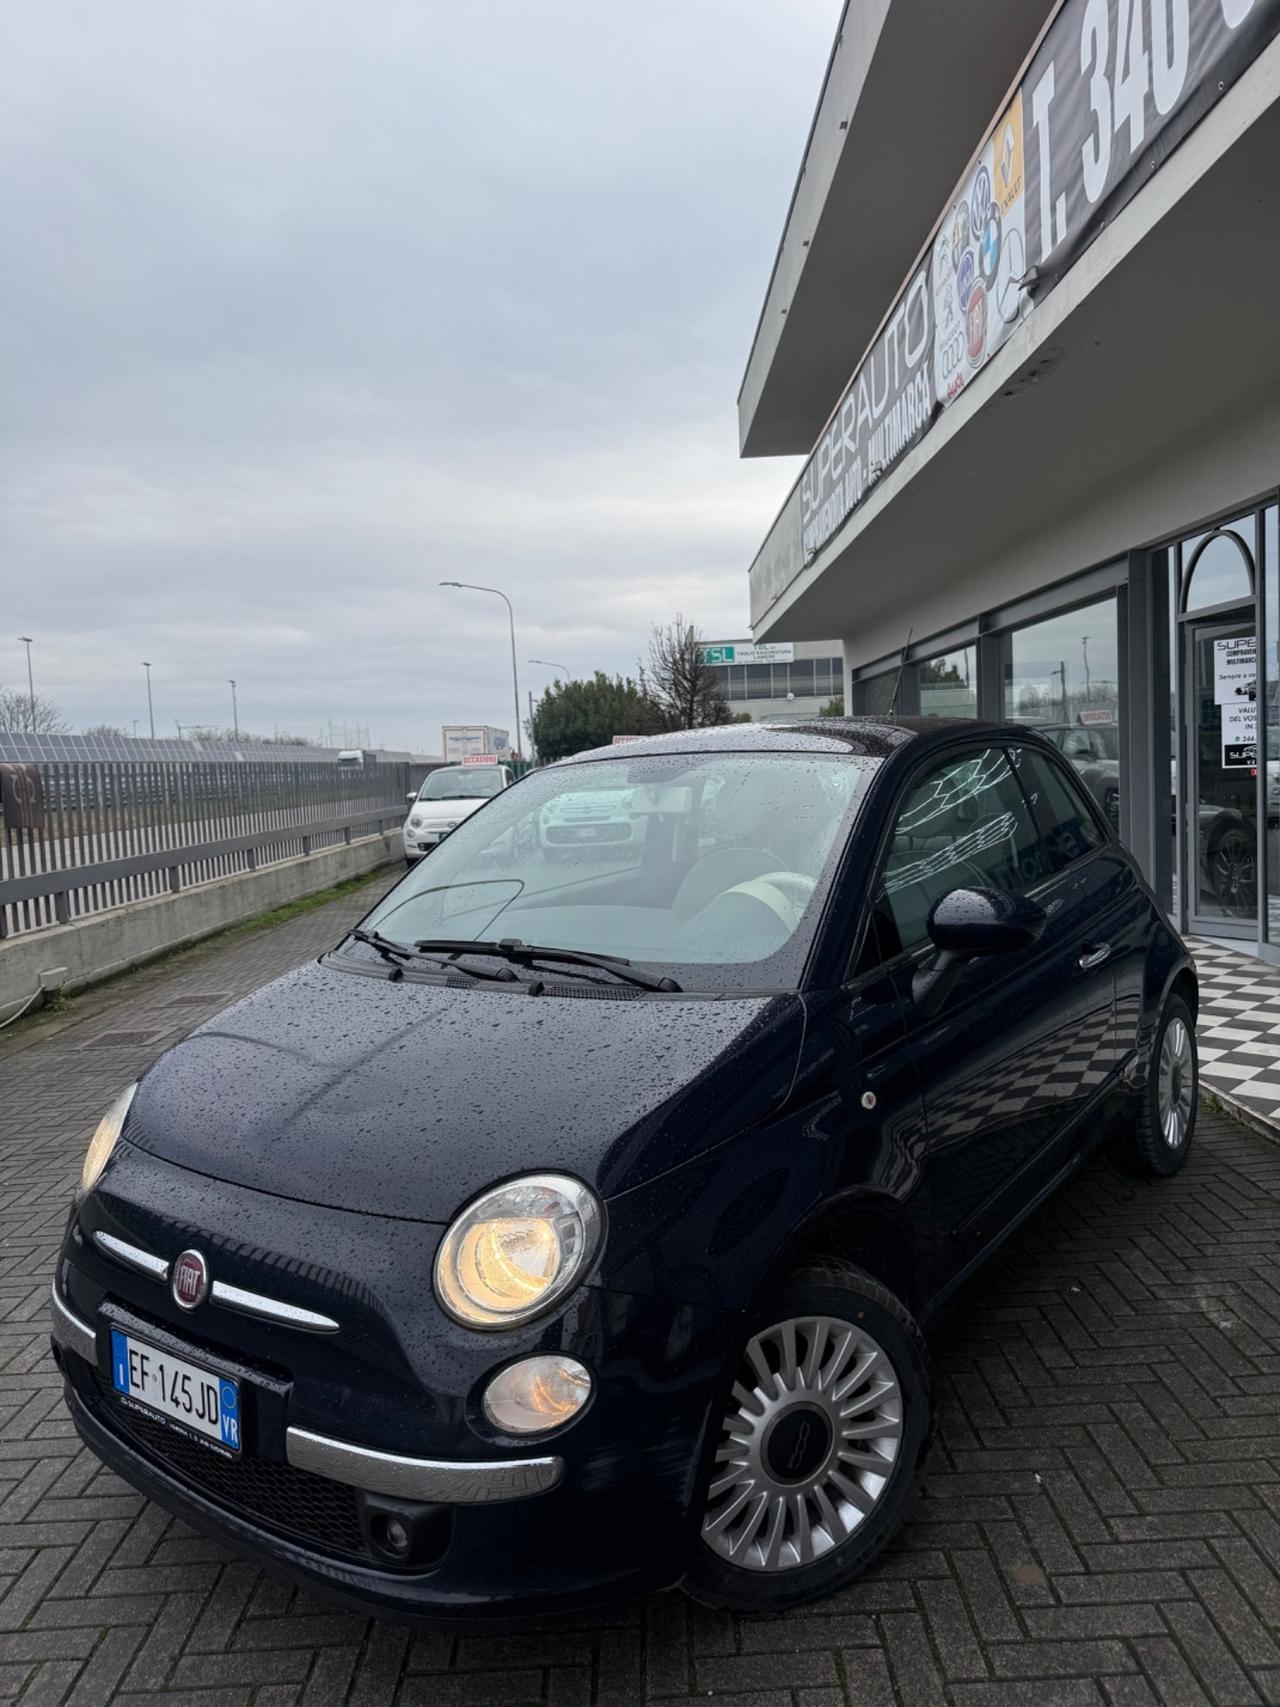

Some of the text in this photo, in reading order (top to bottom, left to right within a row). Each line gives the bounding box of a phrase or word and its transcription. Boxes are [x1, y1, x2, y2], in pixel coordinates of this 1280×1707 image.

[1032, 60, 1067, 263] T.
[803, 270, 928, 524] SUPERAUTO
[178, 1264, 201, 1296] FIAT
[129, 1349, 219, 1425] EF 145JD
[222, 1413, 238, 1444] VR
